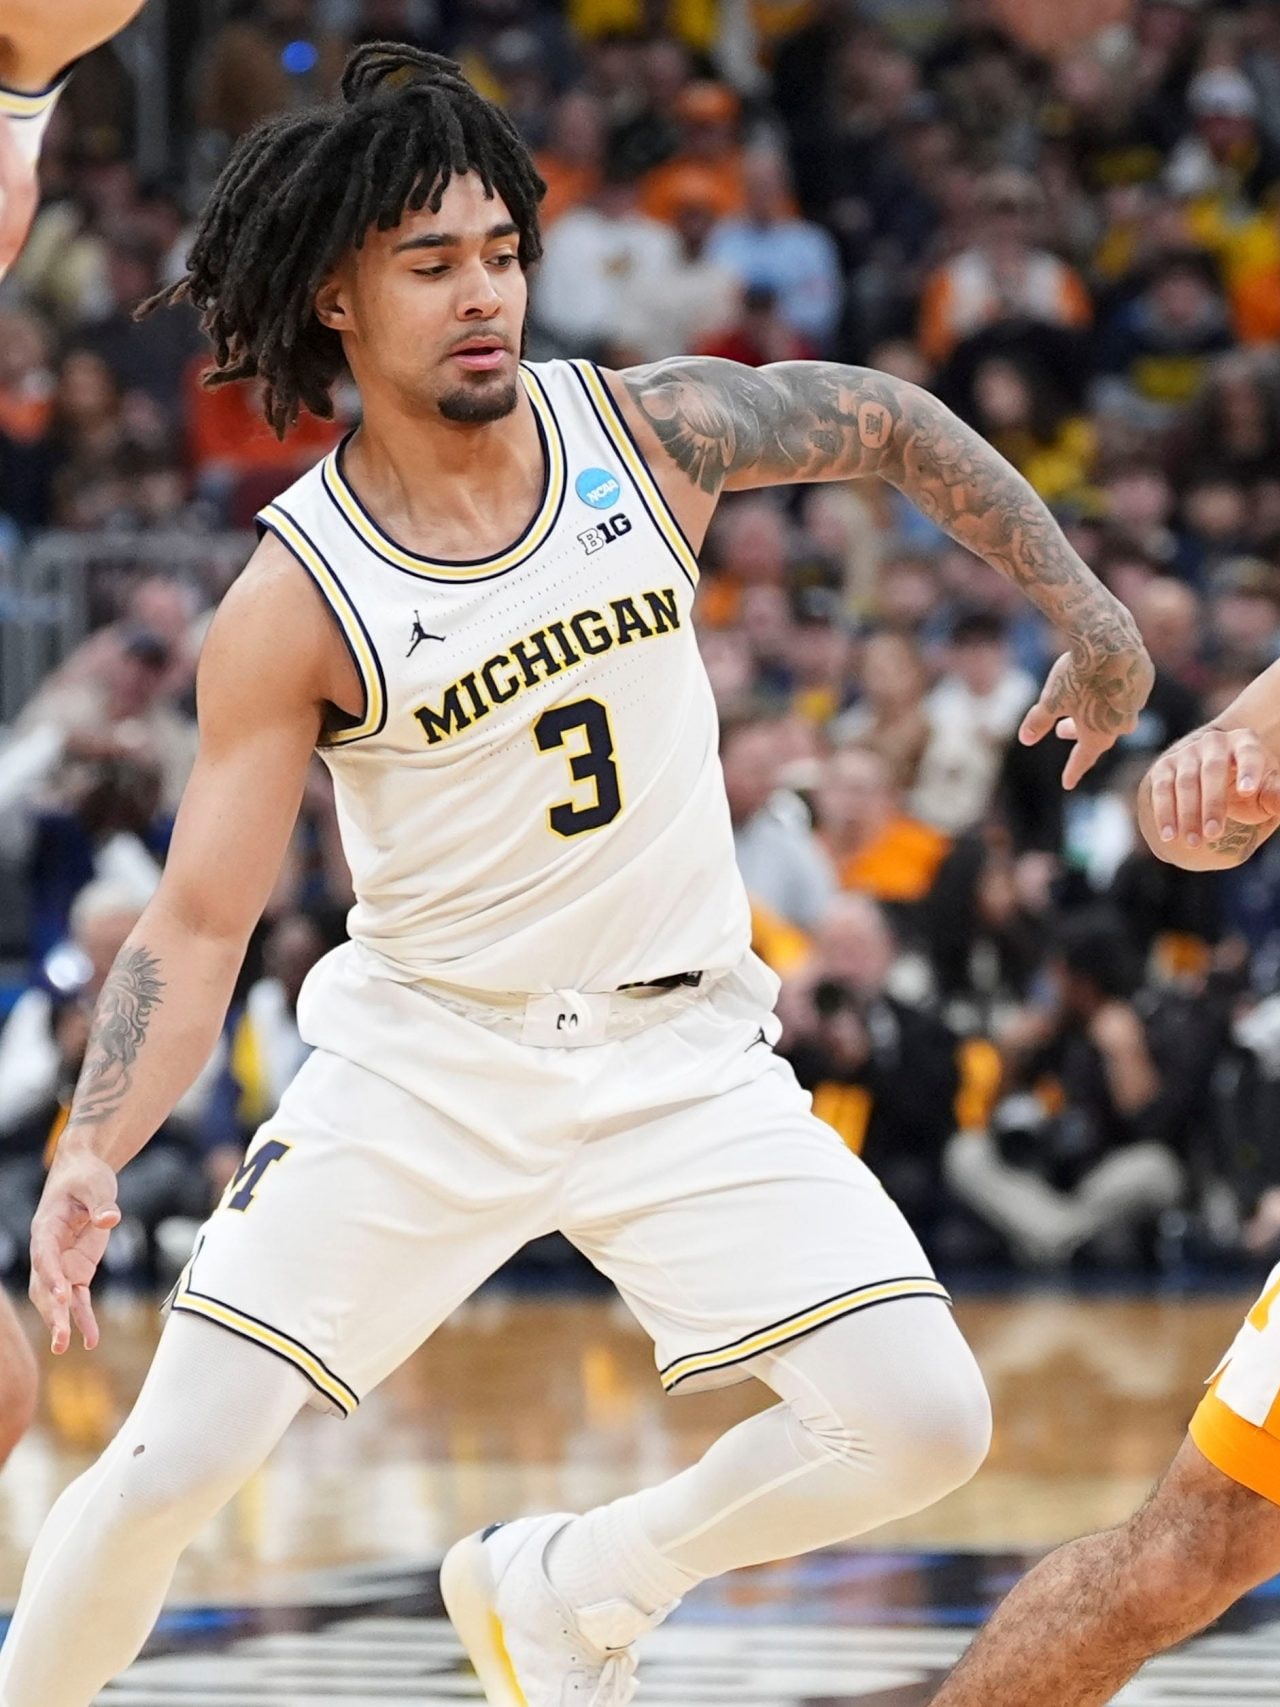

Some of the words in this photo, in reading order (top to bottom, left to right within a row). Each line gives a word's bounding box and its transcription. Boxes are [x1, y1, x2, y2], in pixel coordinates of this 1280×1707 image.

[586, 478, 619, 503] NCAA
[414, 587, 681, 746] MICHIGAN
[532, 696, 622, 838] 3
